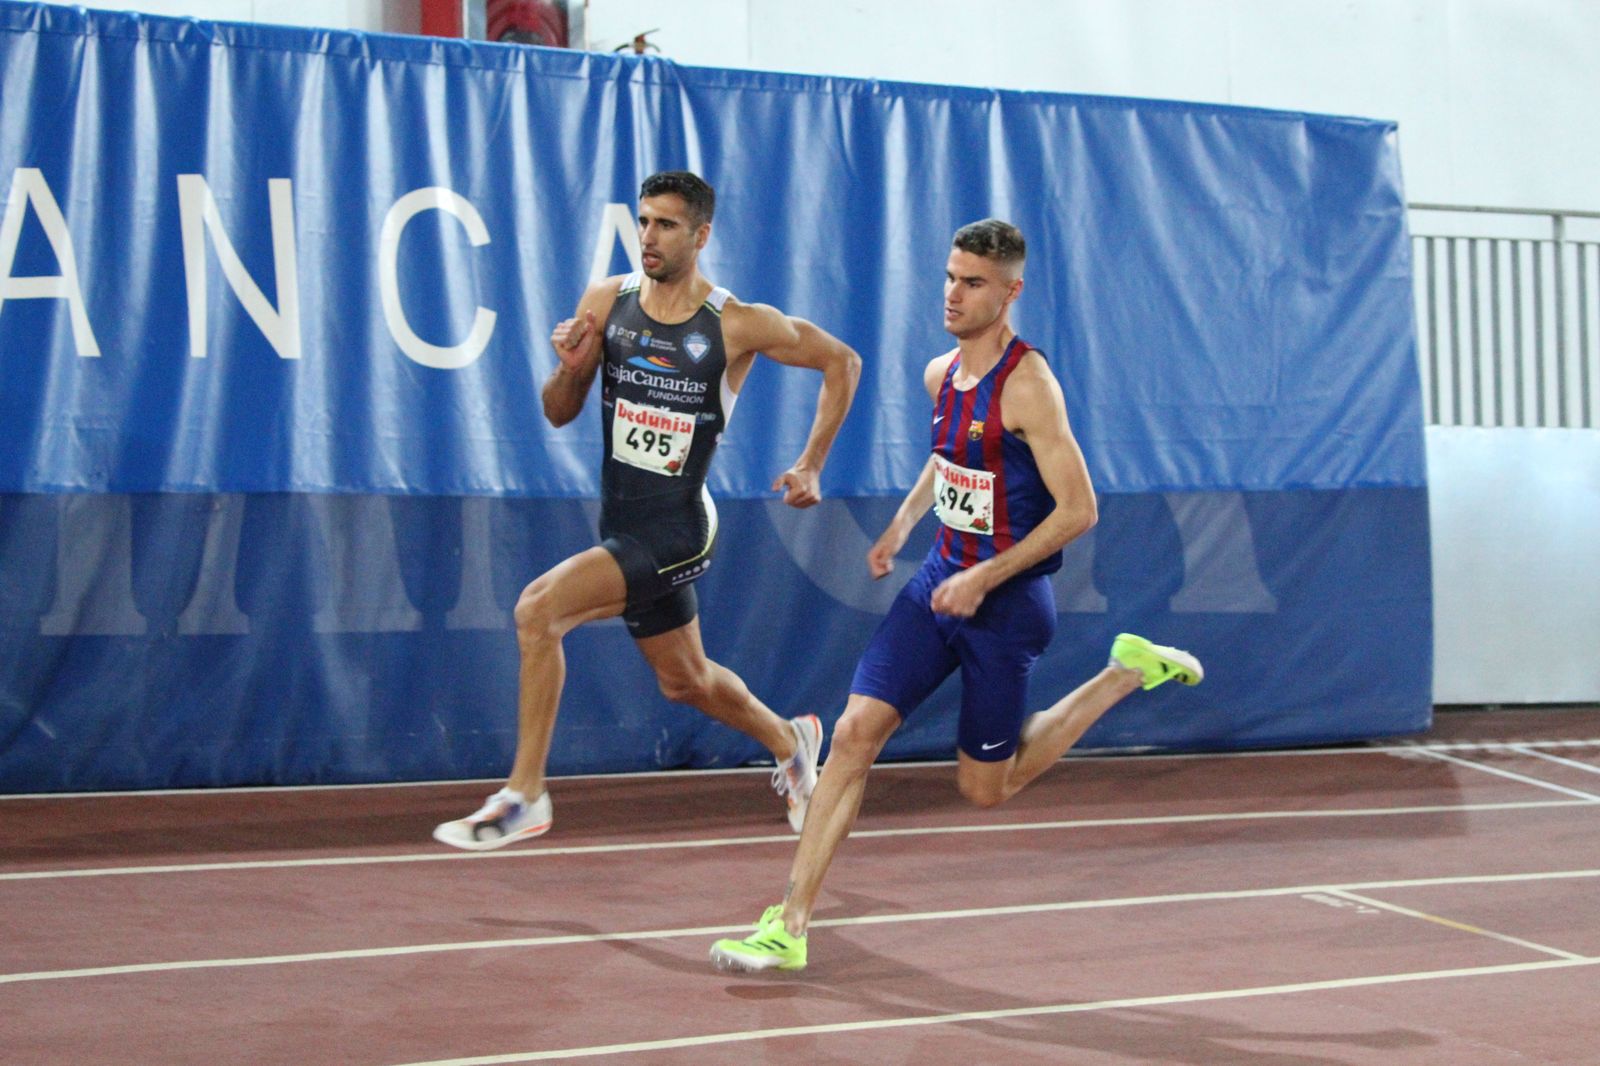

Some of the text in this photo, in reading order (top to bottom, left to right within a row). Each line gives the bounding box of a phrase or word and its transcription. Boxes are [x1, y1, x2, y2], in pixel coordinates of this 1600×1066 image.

[606, 362, 708, 393] CajaCanarias
[647, 389, 705, 404] FUNDACIÓN
[618, 402, 692, 434] bedunia
[626, 427, 673, 457] 495
[935, 461, 991, 490] dunia
